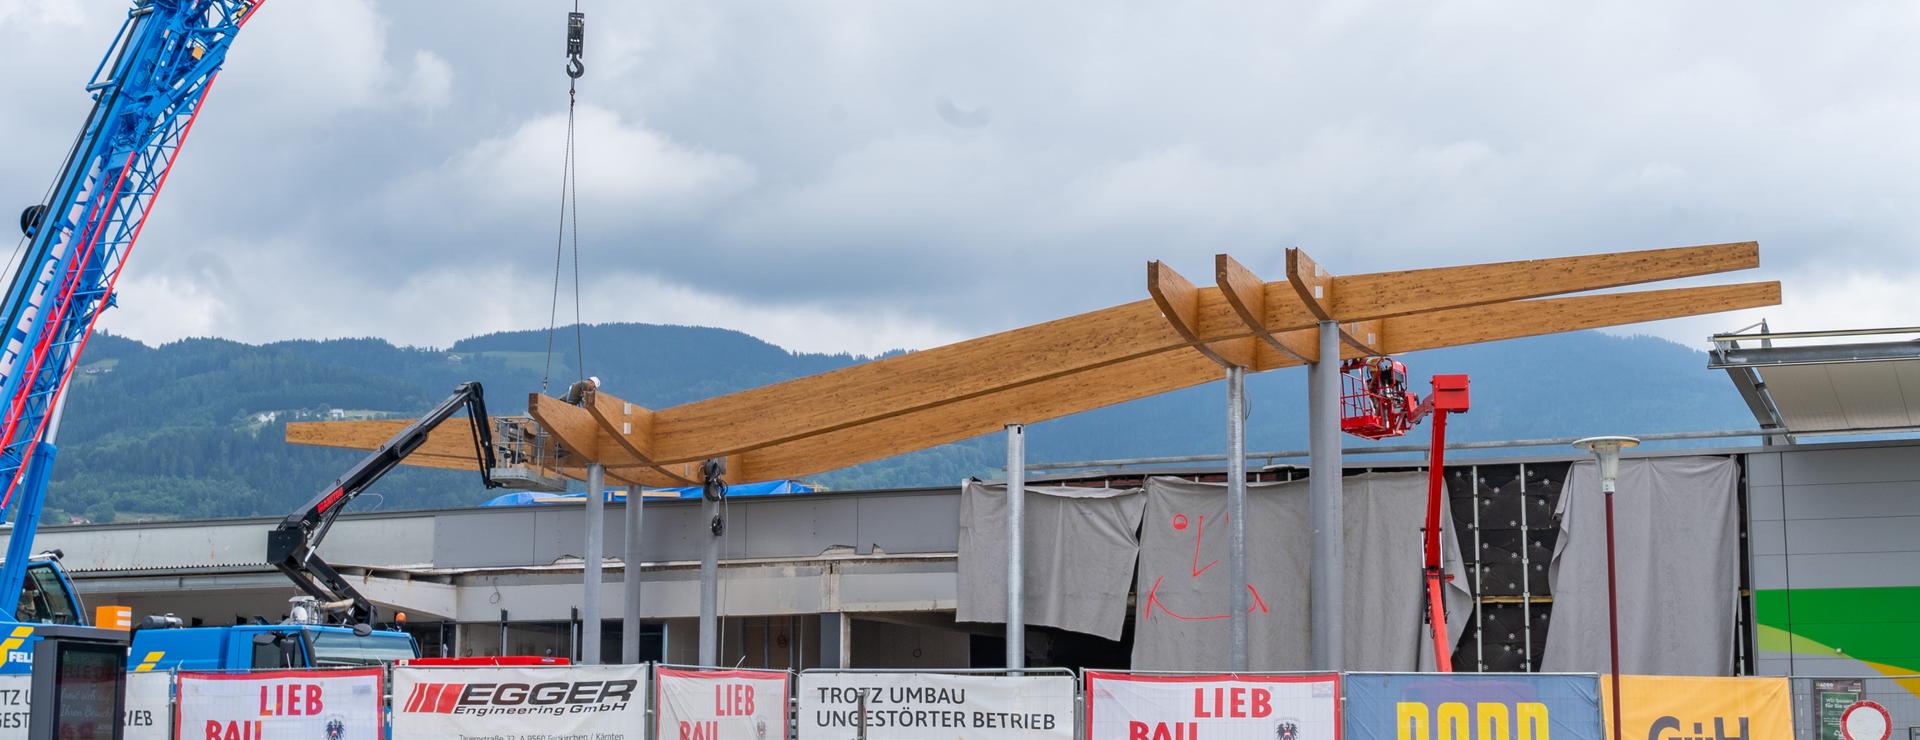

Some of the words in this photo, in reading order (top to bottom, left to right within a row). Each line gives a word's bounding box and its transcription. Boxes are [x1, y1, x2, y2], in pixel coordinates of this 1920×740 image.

[260, 684, 323, 716] LIEB
[458, 680, 638, 706] EGGER
[715, 684, 755, 716] LIEB
[817, 687, 883, 704] TROTZ
[890, 687, 966, 704] UMBAU
[1194, 687, 1272, 718] LIEB
[453, 705, 565, 717] Engineering
[569, 703, 628, 714] GmbH
[816, 707, 968, 728] UNGESTÖRTER
[973, 712, 1055, 730] BETRIEB
